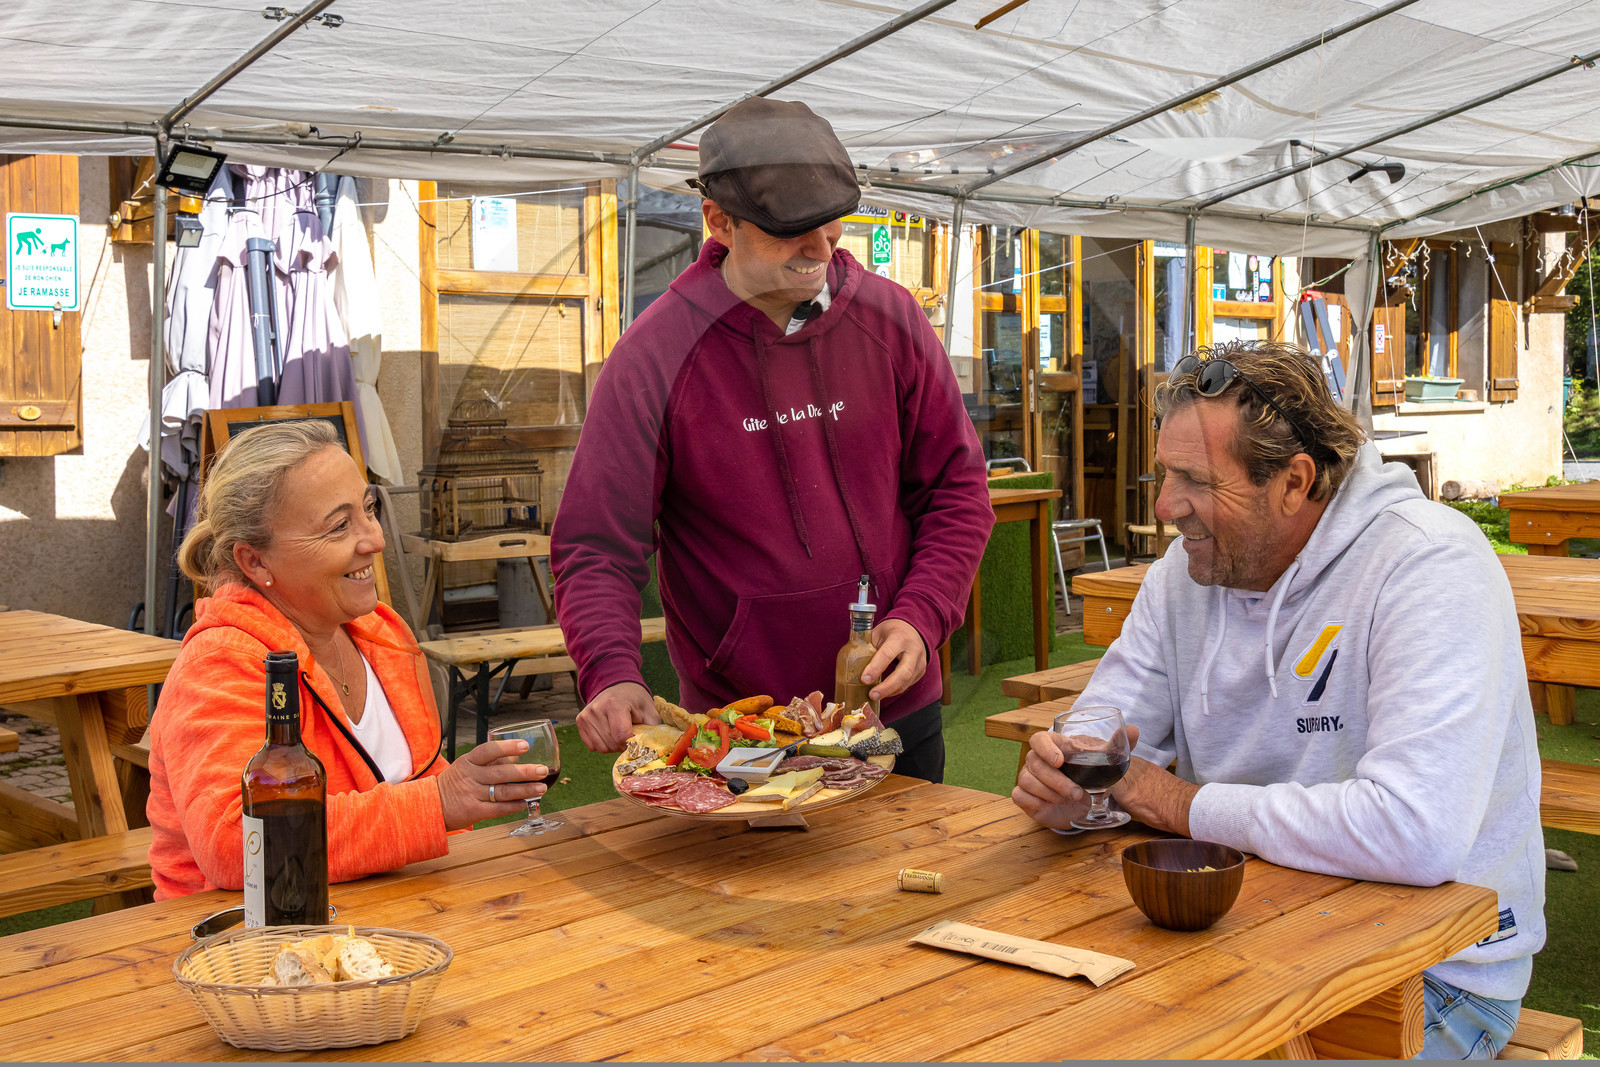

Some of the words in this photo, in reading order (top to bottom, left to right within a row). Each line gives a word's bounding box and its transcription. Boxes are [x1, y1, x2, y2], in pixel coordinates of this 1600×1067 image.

[18, 287, 28, 296] JE
[30, 287, 70, 297] RAMASSE
[790, 407, 806, 421] la
